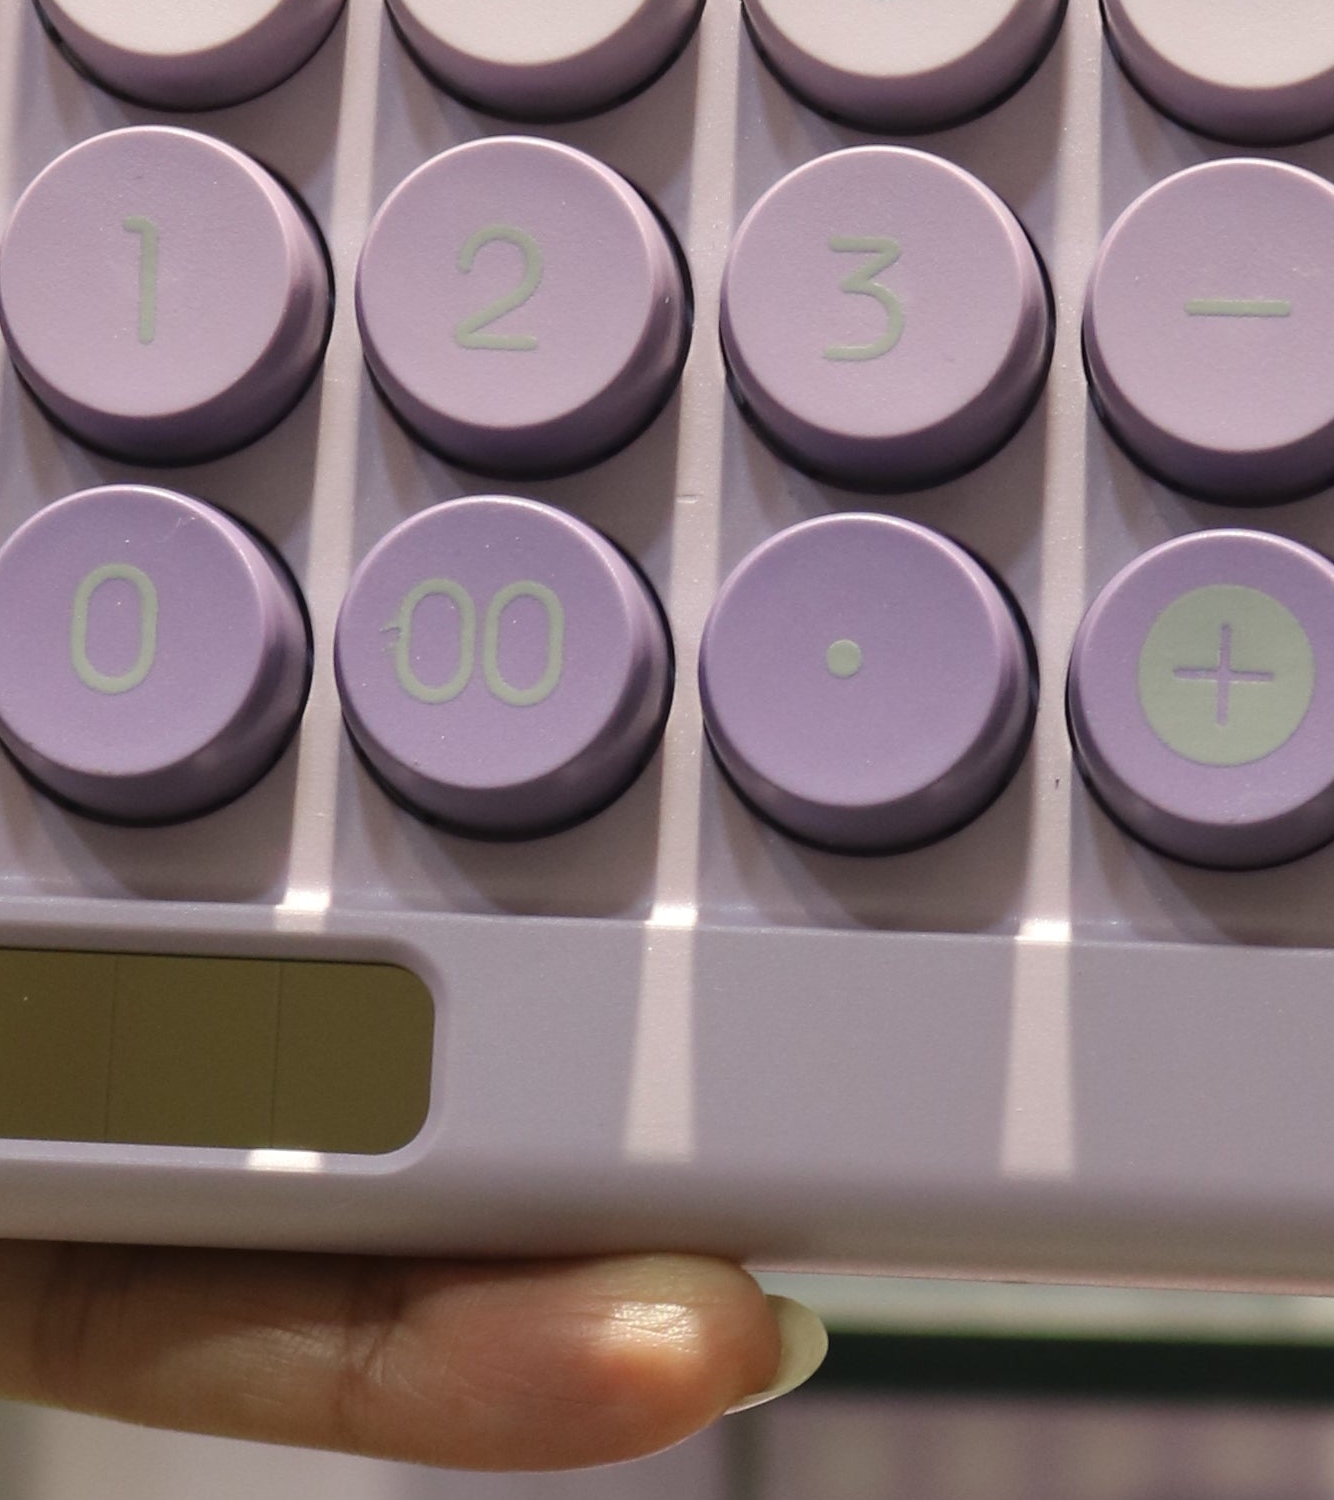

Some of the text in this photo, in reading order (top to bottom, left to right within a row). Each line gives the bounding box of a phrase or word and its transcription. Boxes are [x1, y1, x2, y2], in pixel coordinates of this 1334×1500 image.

[121, 214, 161, 344] 1
[454, 221, 544, 353] 2
[822, 234, 906, 363] 3
[68, 561, 160, 695] 0
[391, 576, 566, 707] 00
